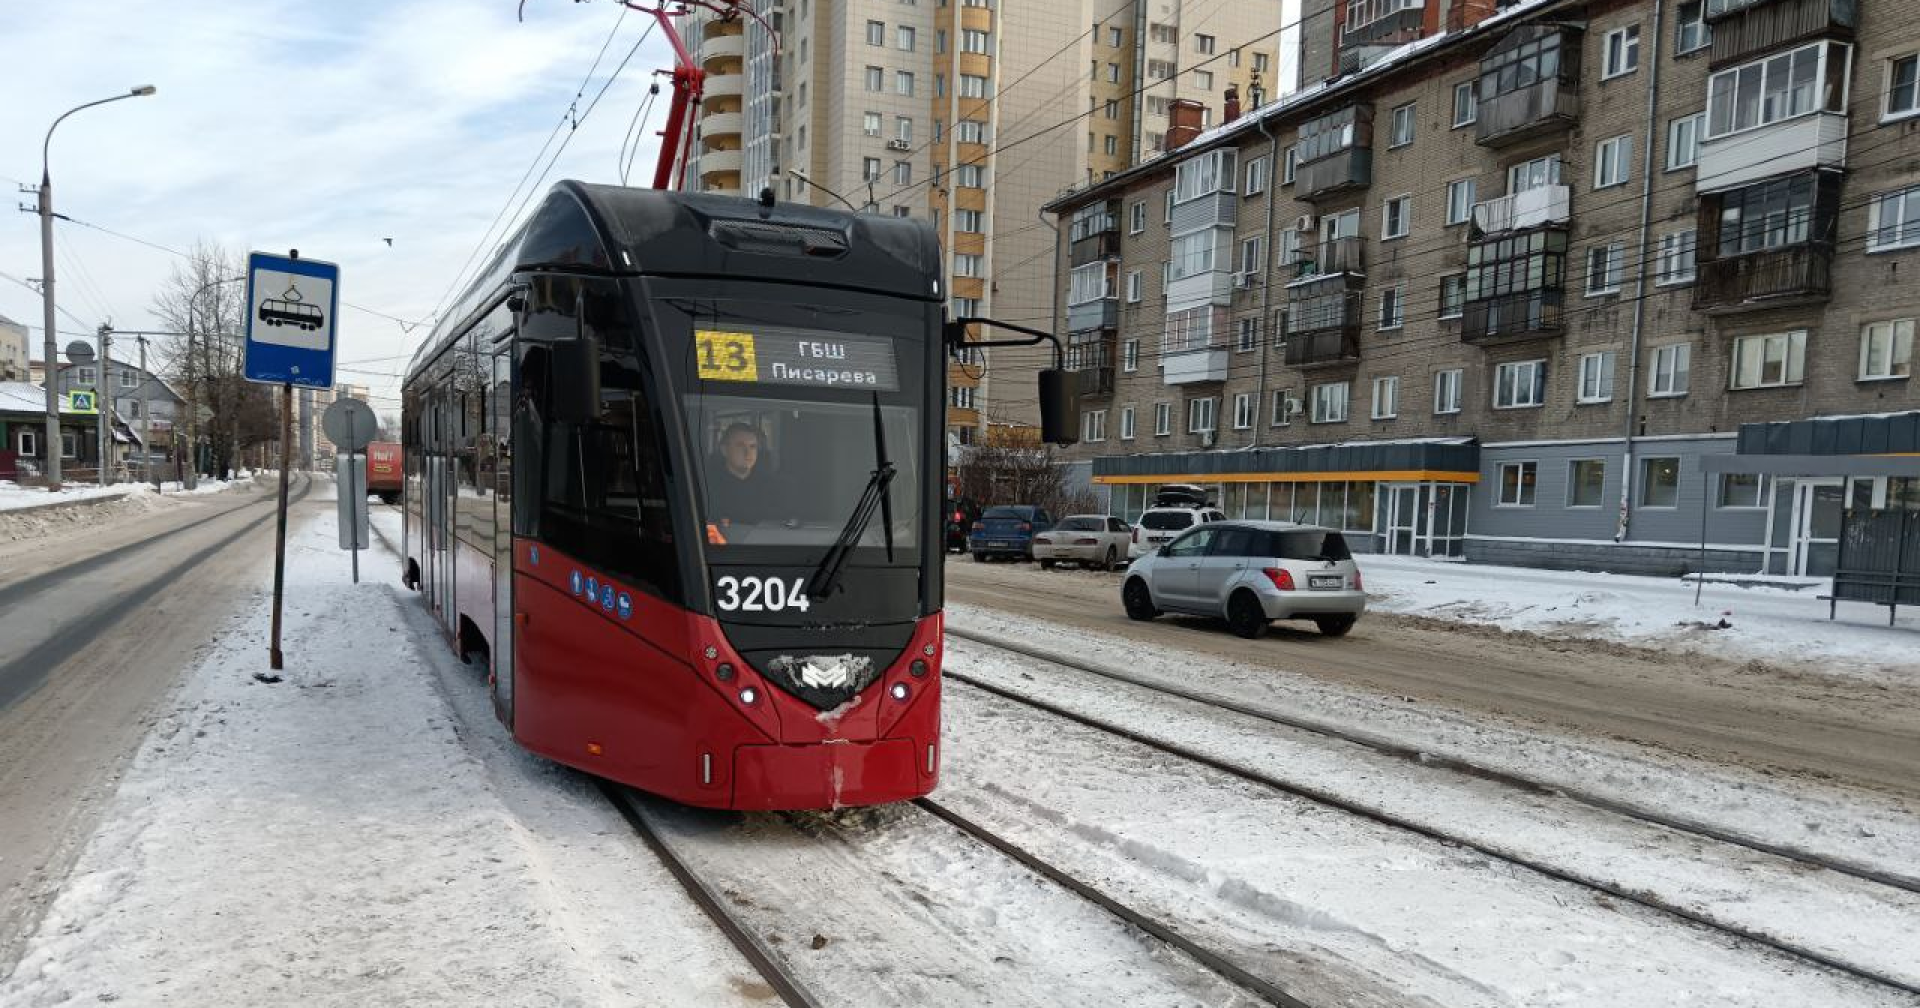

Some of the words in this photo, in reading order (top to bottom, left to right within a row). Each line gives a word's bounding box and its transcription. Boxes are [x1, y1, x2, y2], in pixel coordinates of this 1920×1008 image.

[700, 340, 747, 371] 13
[799, 342, 846, 359] ГБШ
[772, 362, 876, 384] Писарева
[717, 576, 810, 612] 3204
